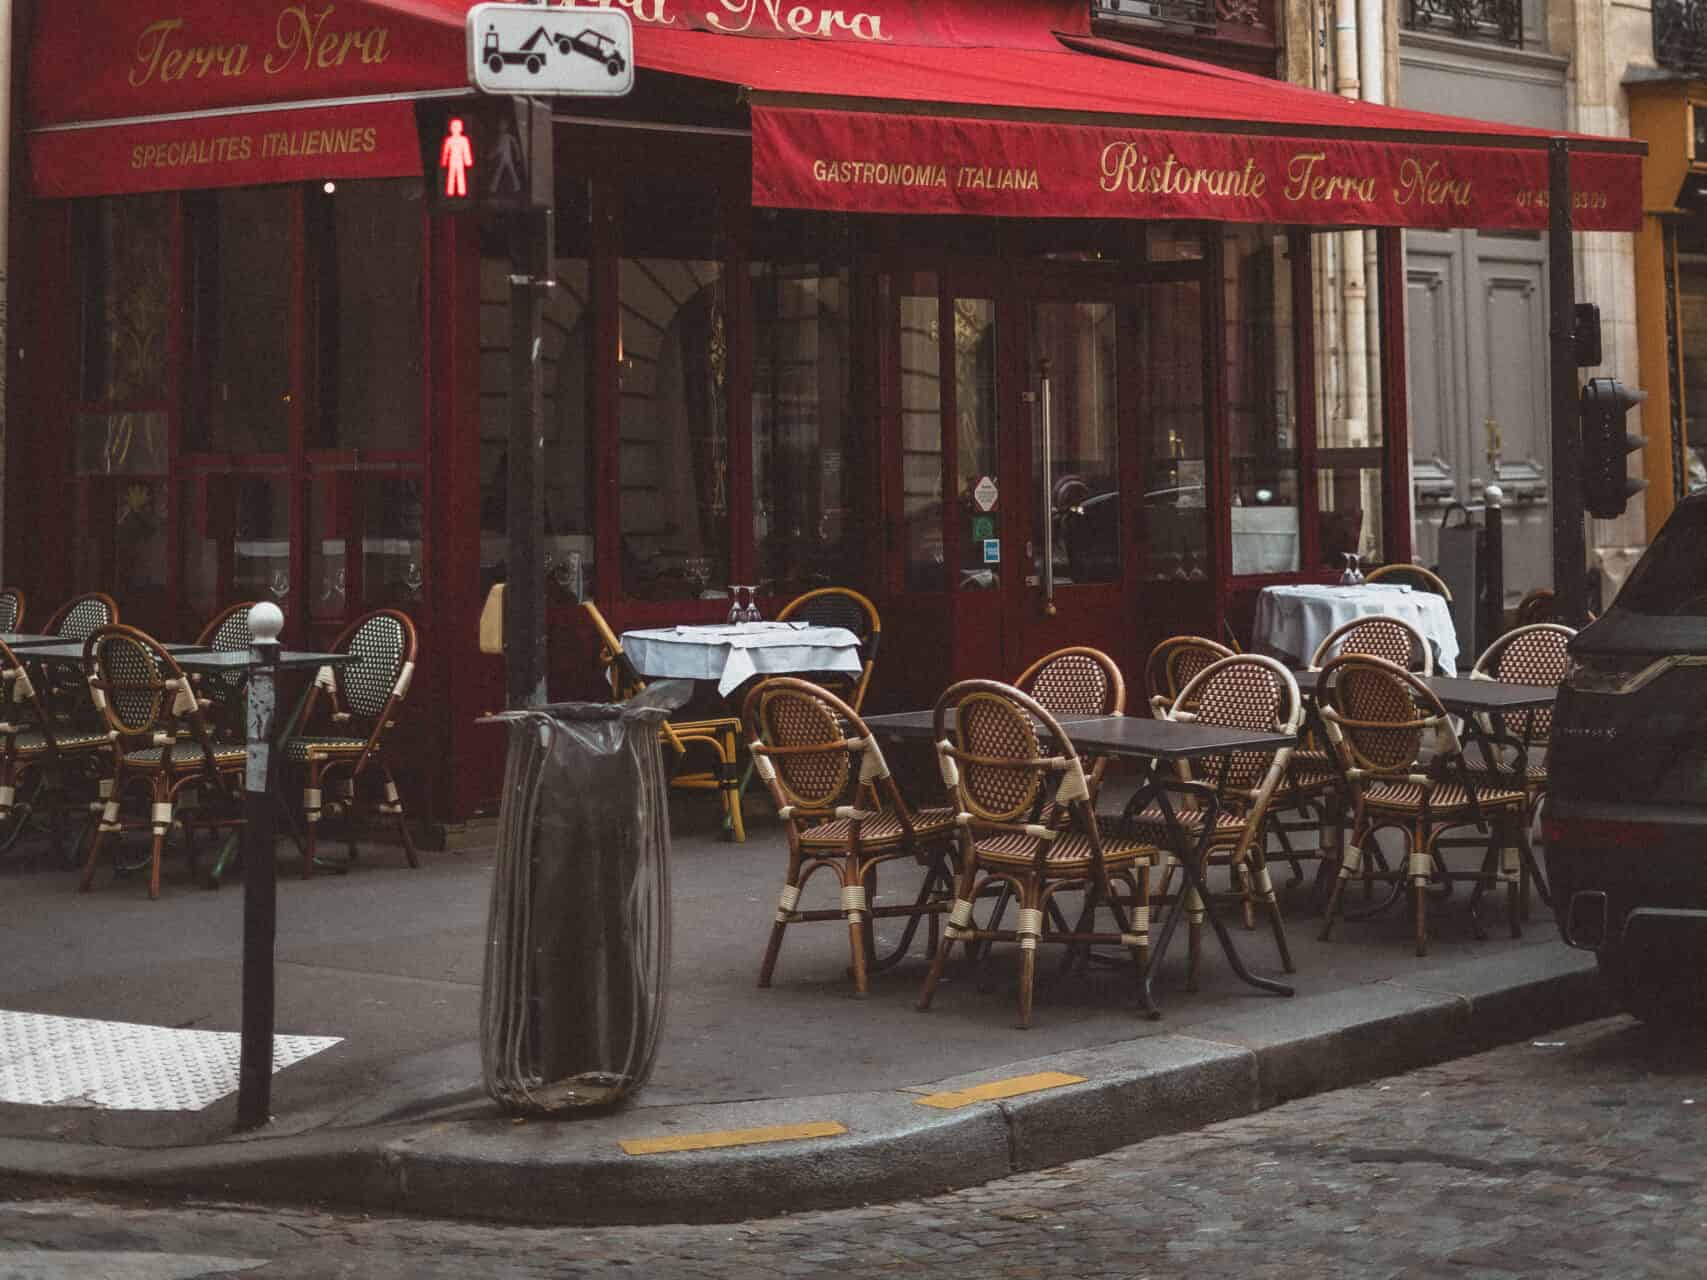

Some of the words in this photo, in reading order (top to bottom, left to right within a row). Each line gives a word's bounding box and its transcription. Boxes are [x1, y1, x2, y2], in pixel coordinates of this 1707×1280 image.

[128, 17, 251, 88] Terra
[264, 3, 391, 74] Nera
[131, 135, 252, 169] SPECIALITES
[261, 127, 377, 156] ITALIENNES
[813, 159, 947, 188] GASTRONOMIA
[956, 165, 1039, 191] ITALIANA
[1099, 141, 1267, 198] Ristorante
[1283, 152, 1376, 203] Terra
[1393, 158, 1473, 207] Nera
